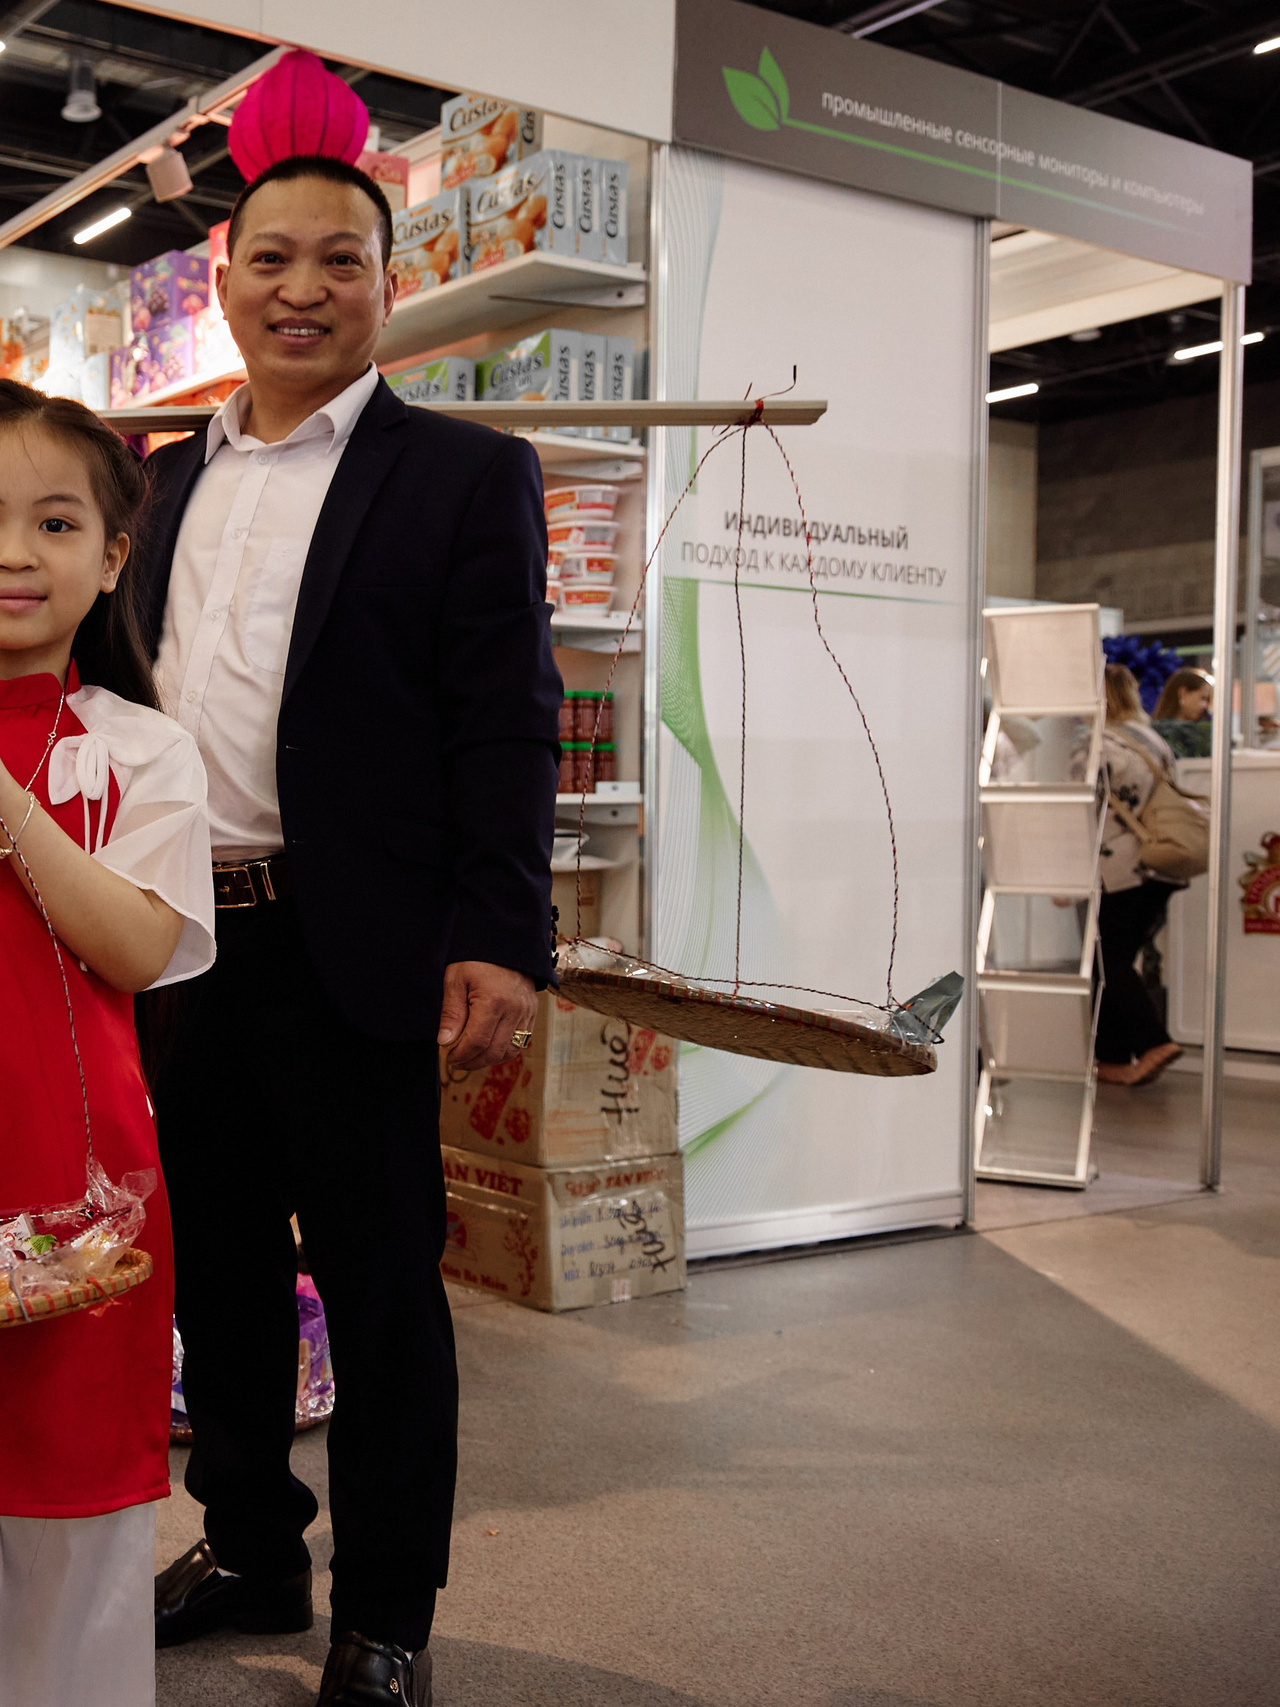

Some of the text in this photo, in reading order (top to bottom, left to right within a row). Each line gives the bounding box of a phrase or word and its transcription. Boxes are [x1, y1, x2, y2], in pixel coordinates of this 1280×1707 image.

[821, 92, 953, 144] промышленные
[954, 130, 1036, 167] сенсорные
[1038, 153, 1110, 189] мониторы
[393, 208, 451, 246] Custas
[552, 164, 566, 229] Custas
[579, 168, 593, 233] Custas
[605, 173, 619, 238] Custas
[724, 511, 910, 550] ИНДИВИДУАЛЬНЫЙ
[681, 541, 947, 588] ПОДХОД К КАЖДОМУ КЛИЕНТУ
